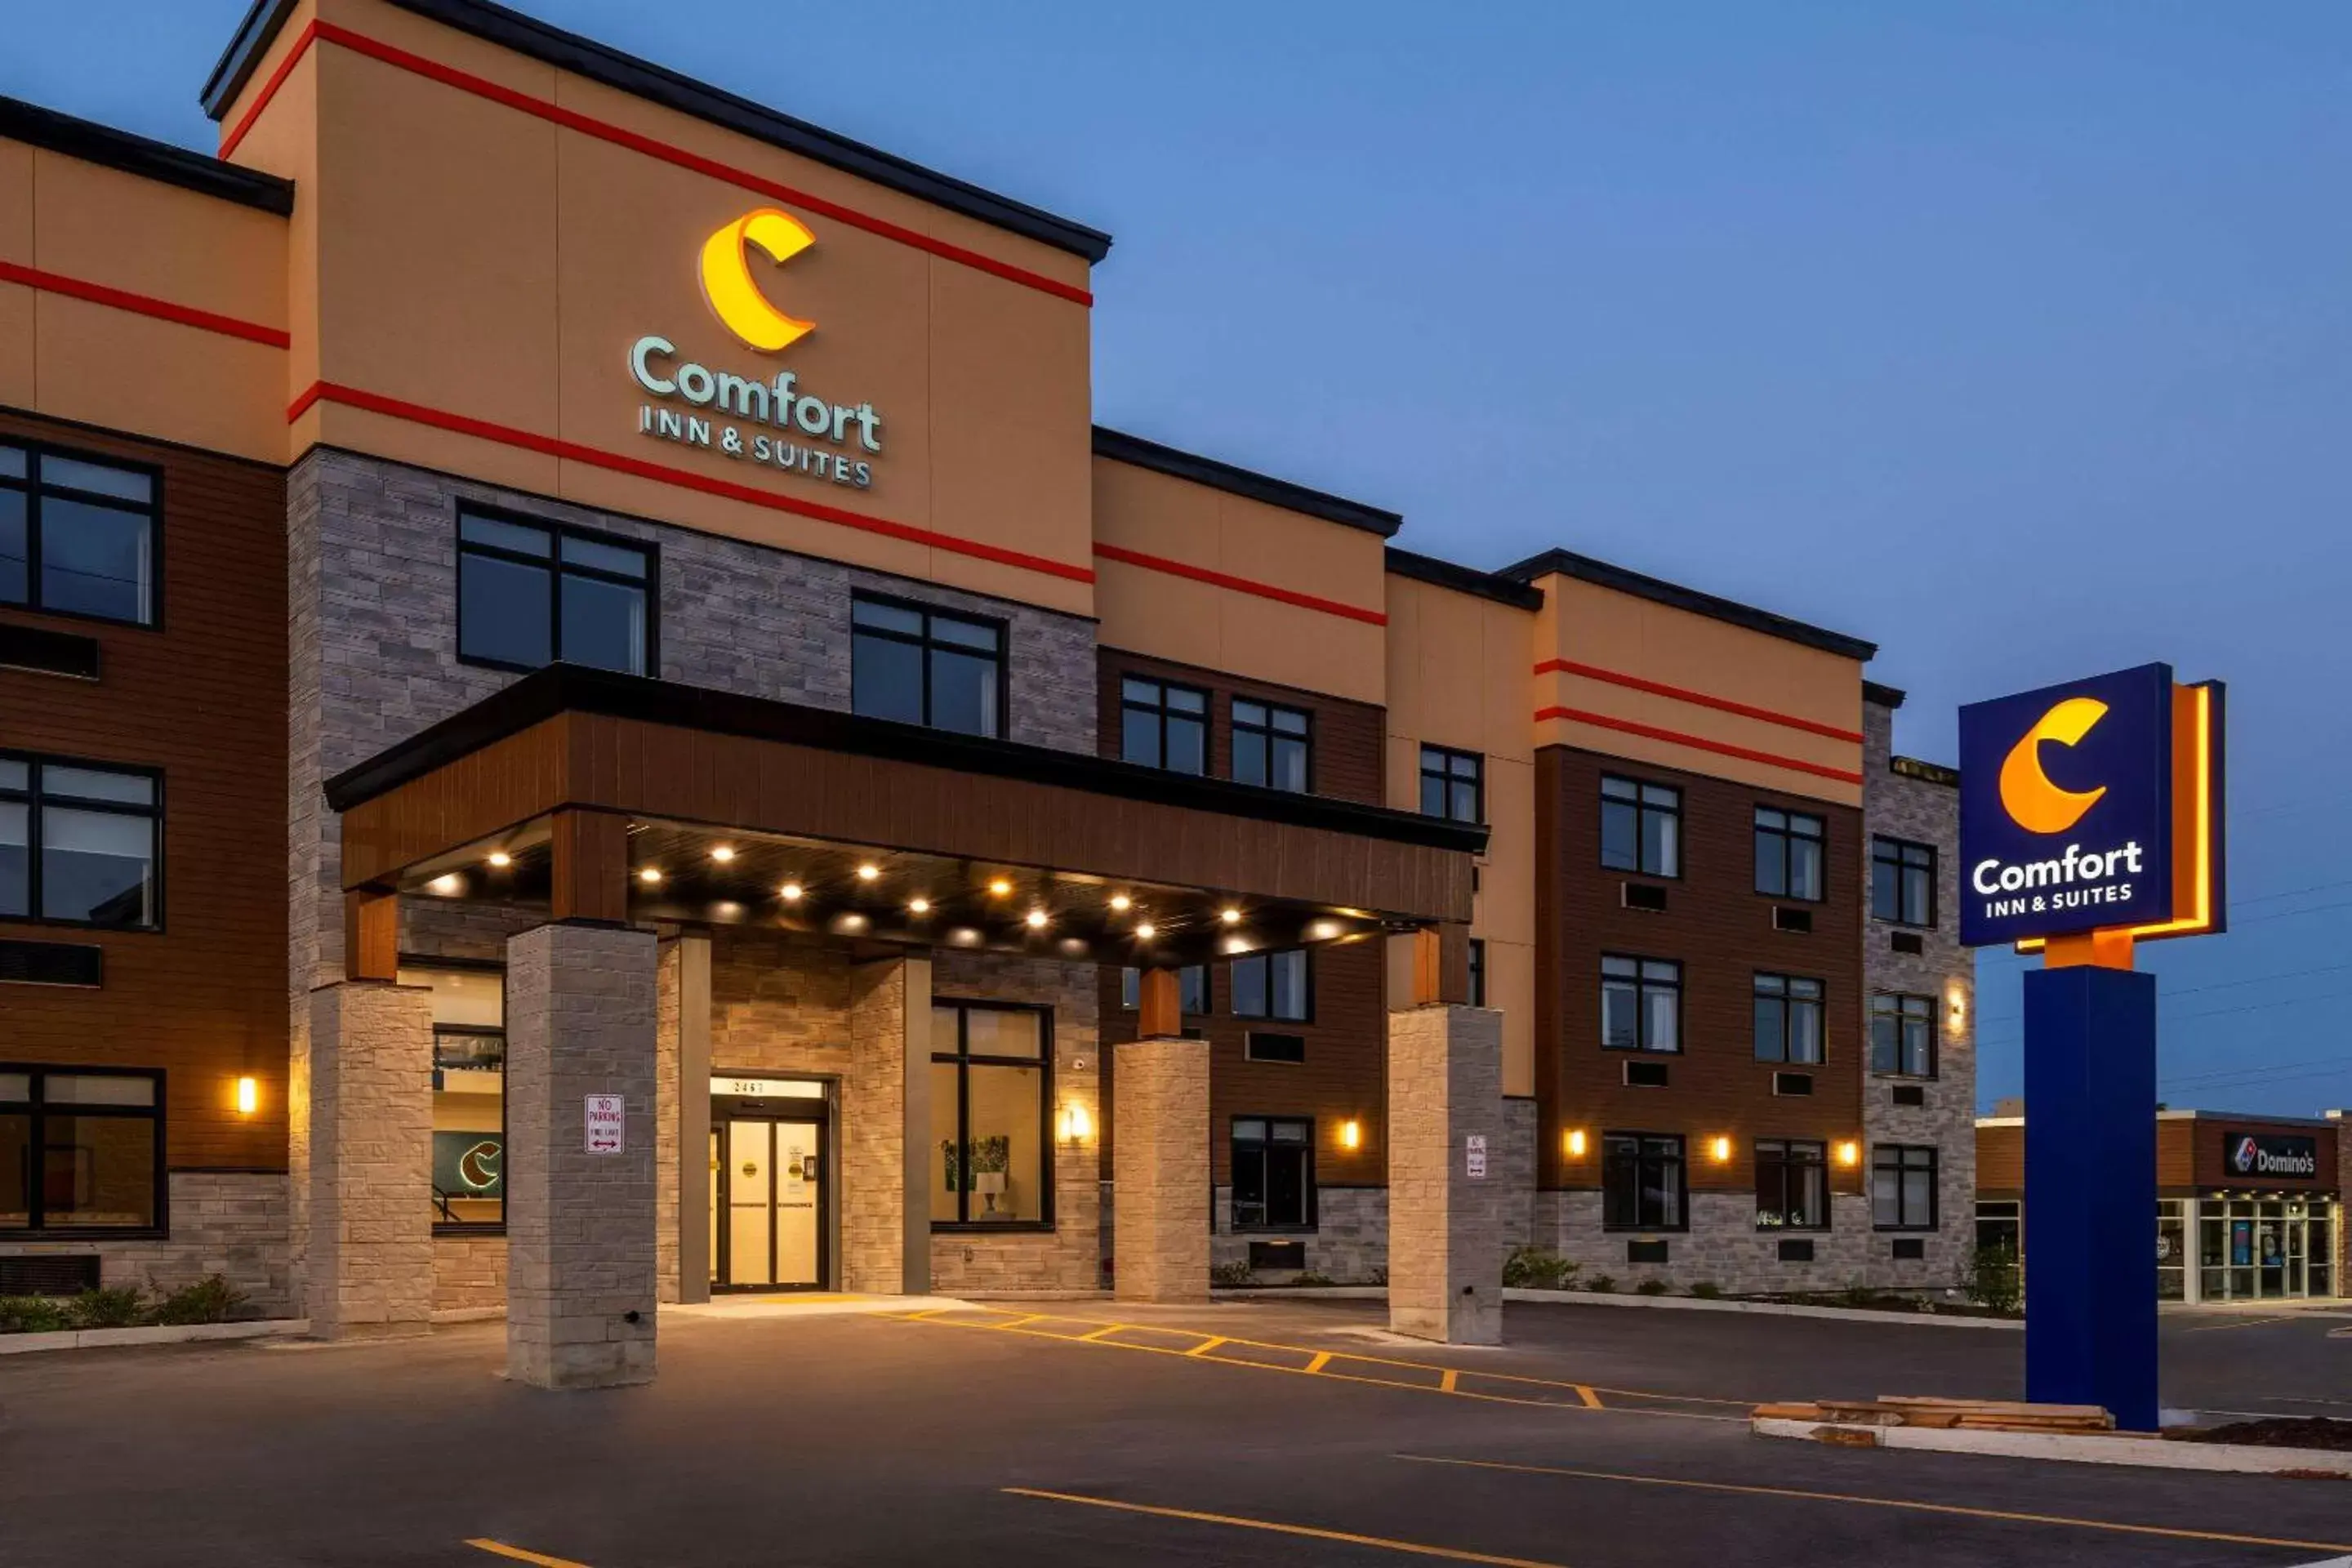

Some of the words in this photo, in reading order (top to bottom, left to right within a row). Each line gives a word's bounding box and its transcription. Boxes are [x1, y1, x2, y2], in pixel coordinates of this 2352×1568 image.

[628, 336, 881, 452] Comfort
[639, 405, 710, 446] INN
[721, 426, 744, 455] &
[753, 434, 871, 487] SUITES
[1973, 841, 2142, 894] Comfort
[1985, 898, 2025, 918] INN
[2032, 896, 2046, 912] &
[2051, 884, 2132, 909] SUITES
[598, 1099, 612, 1111] NO
[2257, 1148, 2314, 1173] Domino's
